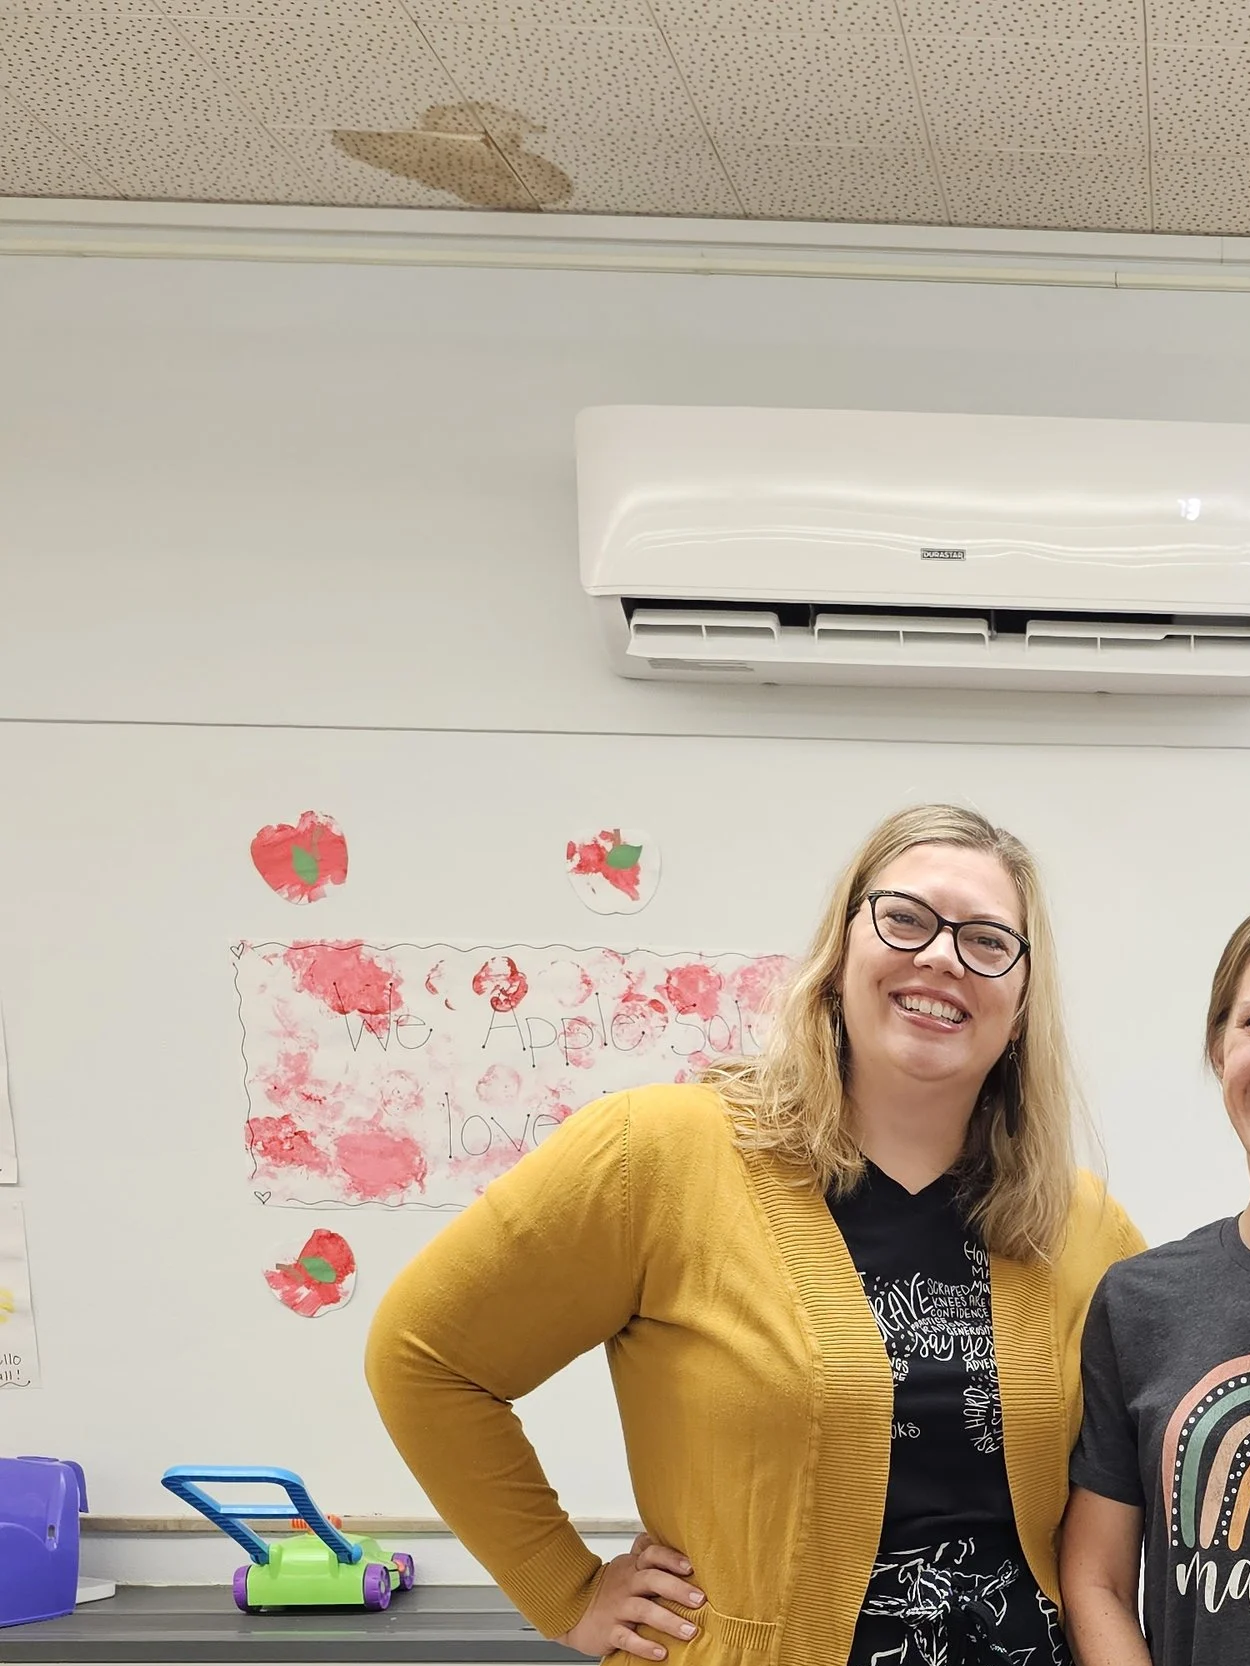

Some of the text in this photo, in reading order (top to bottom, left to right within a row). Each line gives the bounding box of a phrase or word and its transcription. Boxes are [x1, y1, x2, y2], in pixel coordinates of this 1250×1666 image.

[922, 550, 964, 560] DURASTAR
[333, 982, 433, 1051] We
[445, 1092, 562, 1159] love
[927, 1277, 971, 1297] SCRAPED
[932, 1294, 986, 1308] KNEES ARE
[930, 1308, 989, 1319] CONFIDENCE
[910, 1317, 947, 1331] PRACTICE
[921, 1320, 971, 1334] RADICAL
[911, 1331, 954, 1361] say
[963, 1385, 1000, 1454] ASK HARD
